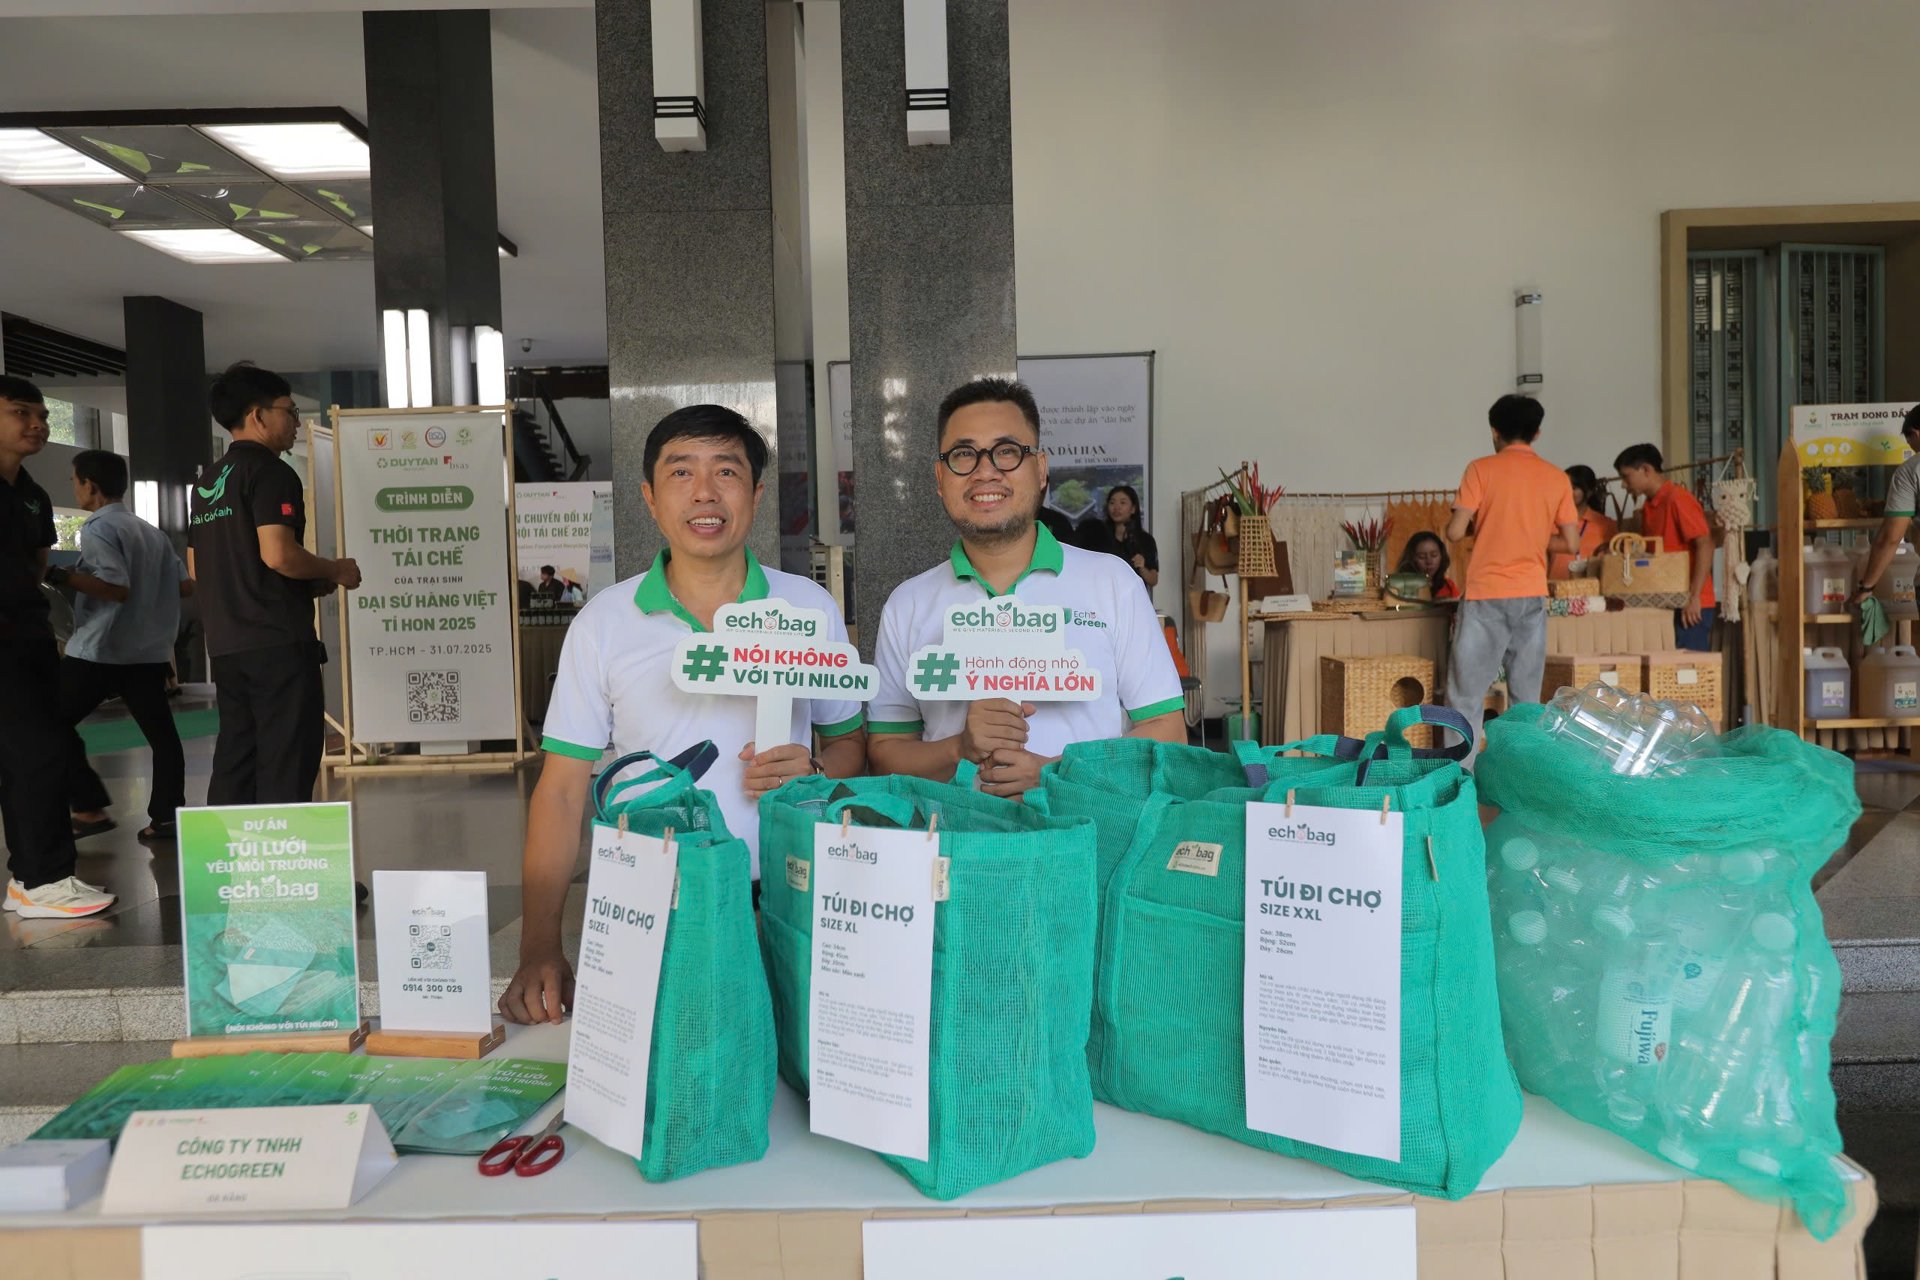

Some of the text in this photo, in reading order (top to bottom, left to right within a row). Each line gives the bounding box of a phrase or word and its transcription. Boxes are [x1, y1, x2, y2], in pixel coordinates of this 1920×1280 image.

[390, 457, 438, 467] DUYTAN
[387, 488, 463, 505] TRÌNH DIỄN
[370, 524, 480, 544] THỜI TRANG
[392, 545, 464, 566] TÁI CHẾ
[394, 575, 463, 586] CỦA TRẠI SINH
[358, 596, 386, 613] ĐẠI
[390, 592, 413, 608] SỨ
[416, 592, 460, 608] HÀNG
[463, 590, 498, 610] VIỆT
[382, 616, 476, 632] TÍ HON 2025
[726, 610, 816, 636] echobag
[952, 604, 1057, 634] echobag
[1074, 618, 1106, 628] Green
[369, 646, 416, 656] TP.HCM
[430, 644, 492, 655] 31.07.2025
[734, 644, 848, 668] NÓI KHÔNG
[682, 644, 728, 682] #
[914, 653, 960, 692] #
[965, 656, 1079, 672] Hành động nhỏ
[733, 665, 868, 690] VỚI TÚI NILON
[966, 670, 1094, 692] Ý NGHĨA LỚN
[244, 818, 288, 834] DỰ ÁN
[226, 837, 306, 858] TÚI LƯỚI
[206, 857, 328, 874] YÊU MÔI TRƯỜNG
[1261, 876, 1382, 914] TÚI ĐI CHỢ
[592, 896, 656, 934] TÚI ĐI CHỢ
[822, 892, 914, 927] TÚI ĐI CHỢ
[1260, 902, 1322, 922] SIZE XXL
[588, 919, 610, 936] SIZE L
[820, 917, 858, 934] SIZE XL
[402, 984, 422, 992] 0914
[426, 984, 443, 992] 300
[1637, 1010, 1658, 1064] Fujiwa
[177, 1137, 302, 1156] CÔNG TY TNHH
[180, 1162, 286, 1180] ECHOGREEN
